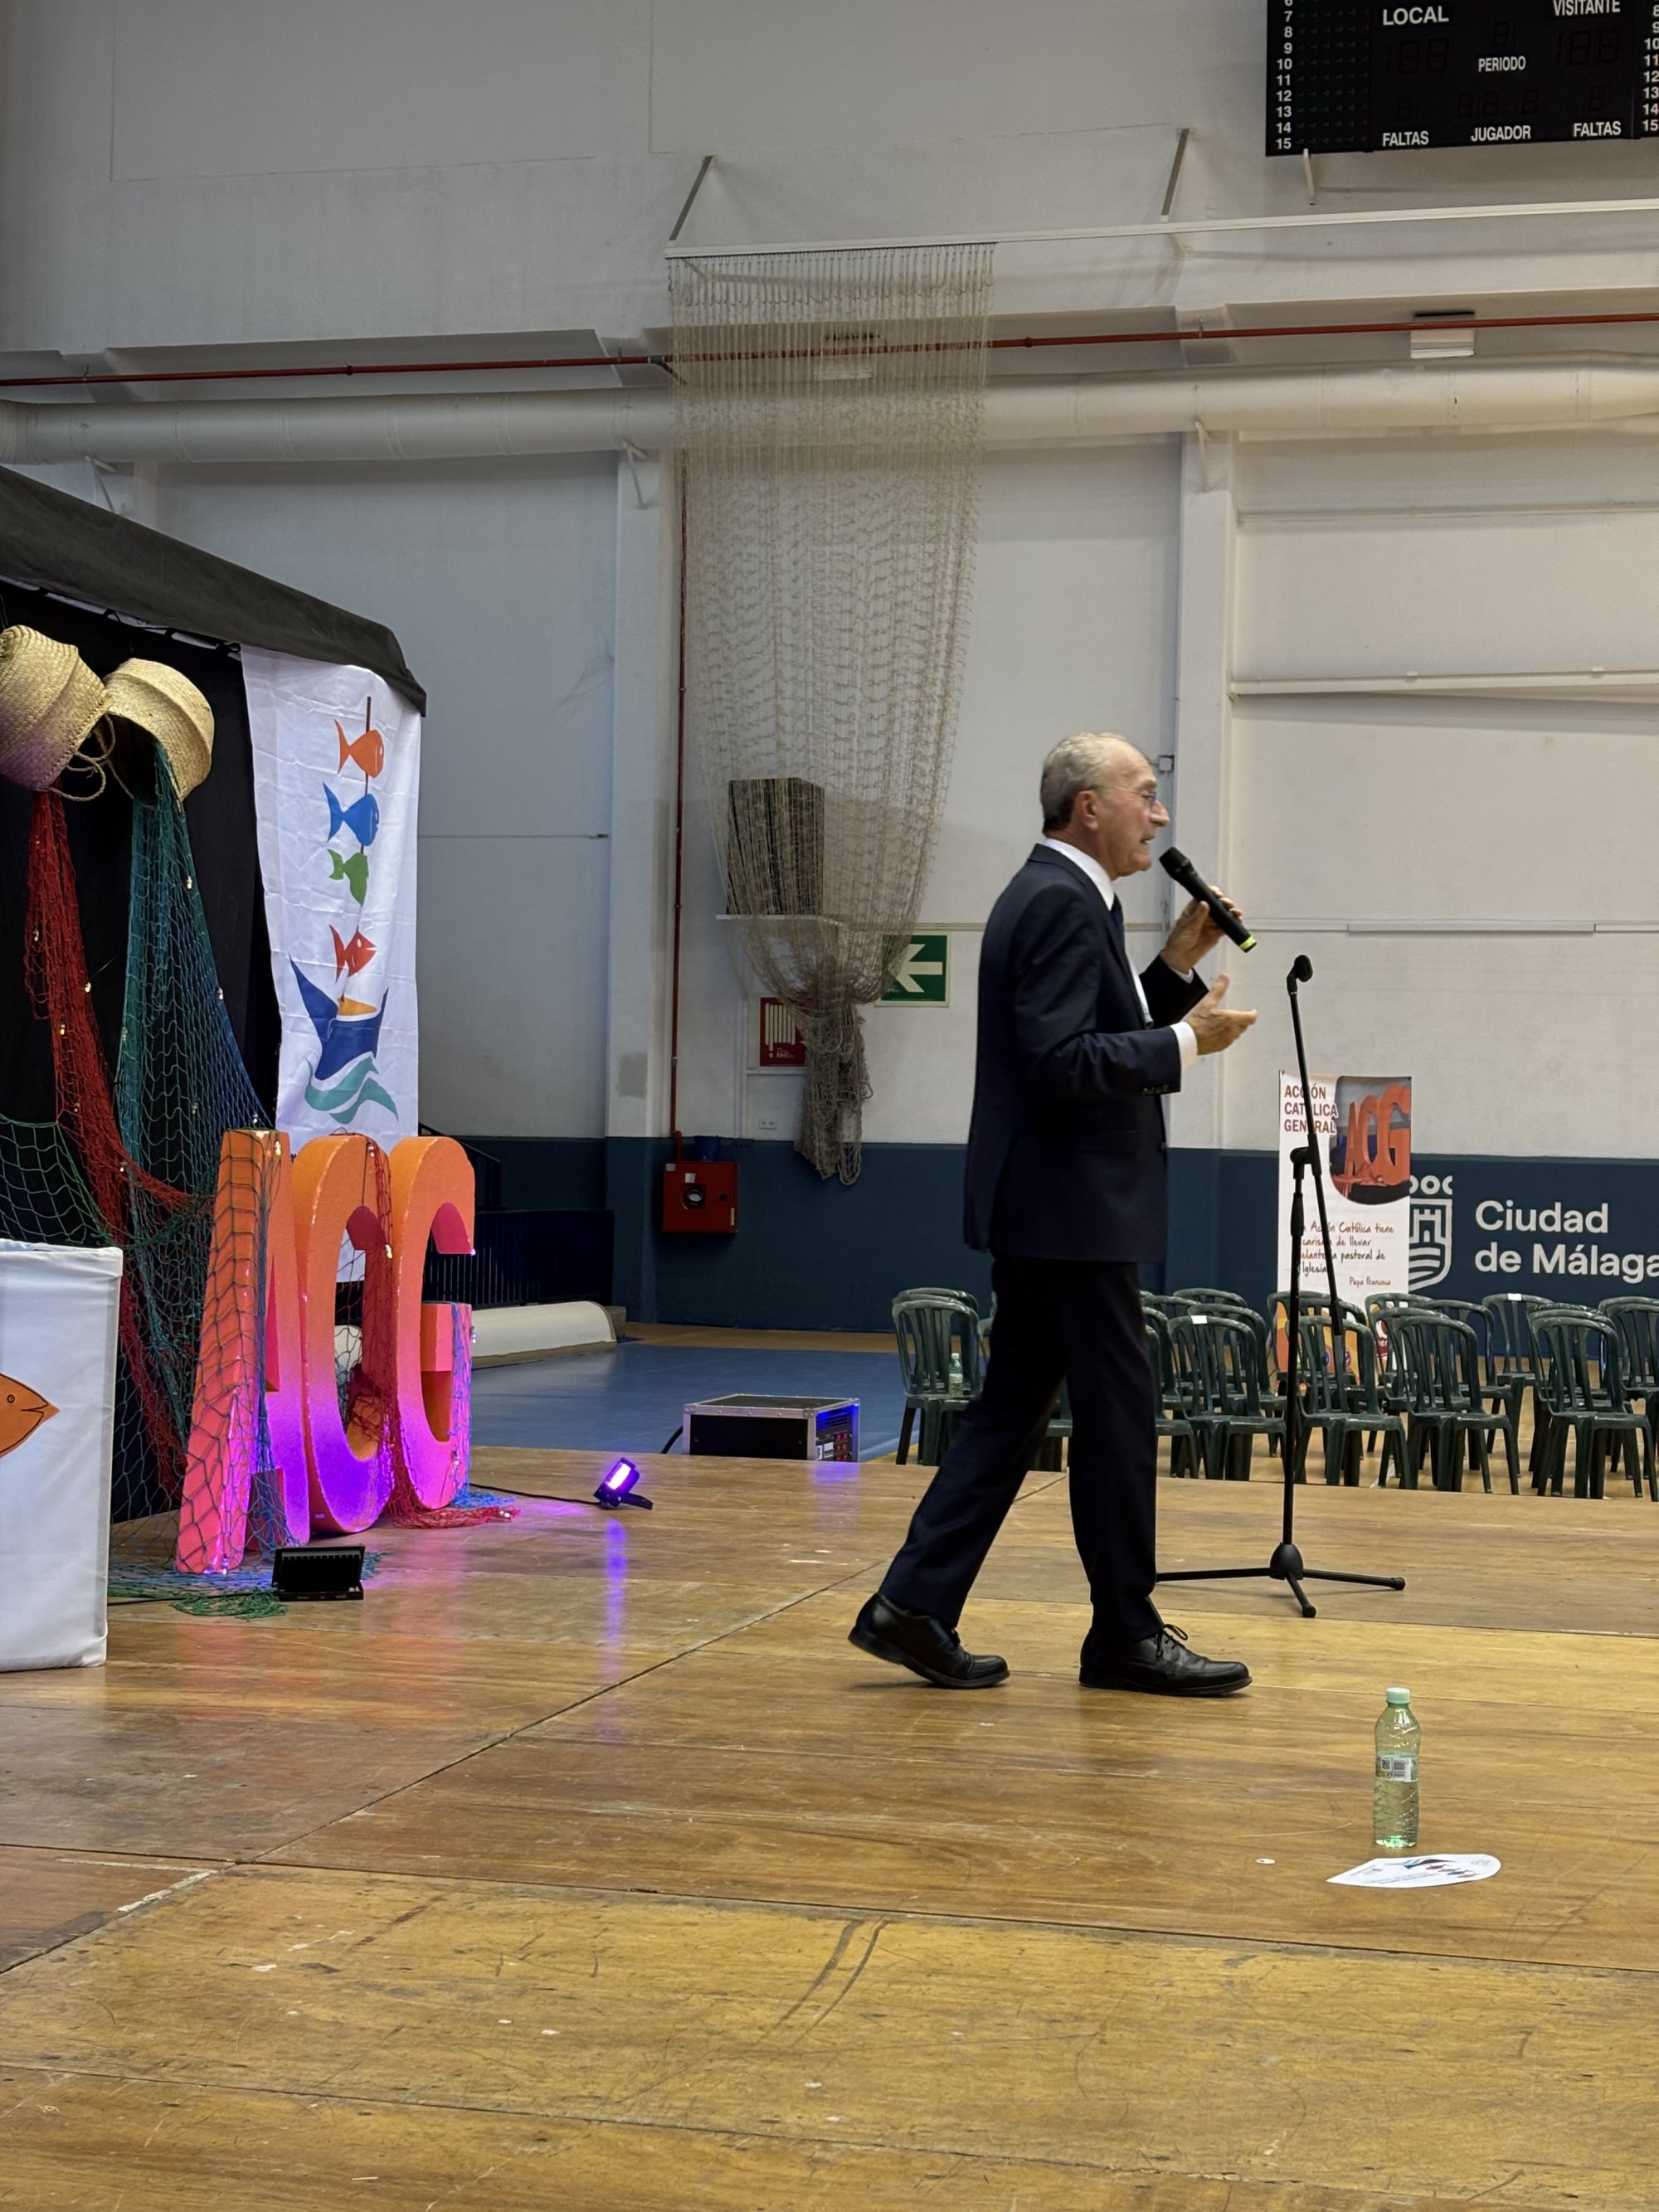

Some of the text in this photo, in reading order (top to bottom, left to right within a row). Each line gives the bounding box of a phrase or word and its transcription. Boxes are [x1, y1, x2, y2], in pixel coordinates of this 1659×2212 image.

[1553, 0, 1621, 17] VISITANTE
[1283, 11, 1293, 22] 7
[1382, 6, 1449, 26] LOCAL
[1283, 26, 1293, 38] 8
[1283, 42, 1293, 55] 9
[1644, 37, 1659, 51] 10
[1276, 58, 1293, 70] 10
[1478, 56, 1526, 72] PERIODO
[1644, 54, 1659, 67] 11
[1276, 74, 1291, 86] 11
[1643, 70, 1659, 83] 12
[1276, 90, 1292, 102] 12
[1643, 86, 1659, 100] 13
[1276, 105, 1292, 118] 13
[1642, 103, 1659, 116] 14
[1275, 122, 1292, 134] 14
[1573, 120, 1622, 138] FALTAS
[1642, 119, 1659, 132] 15
[1382, 131, 1429, 147] FALTAS
[1470, 125, 1531, 142] JUGADOR
[1275, 138, 1292, 149] 15
[1284, 1101, 1337, 1117] CATLICA
[1284, 1119, 1336, 1134] GENRAL
[1475, 1199, 1608, 1233] Ciudad
[1339, 1222, 1372, 1233] Católica
[1374, 1223, 1394, 1233] tiene
[1336, 1236, 1346, 1246] de
[1350, 1236, 1372, 1247] llevar
[1340, 1249, 1373, 1263] pastoral
[1375, 1249, 1386, 1260] de
[1302, 1261, 1327, 1277] Iglesia
[1475, 1242, 1659, 1284] de Málaga
[1349, 1276, 1364, 1288] Papa
